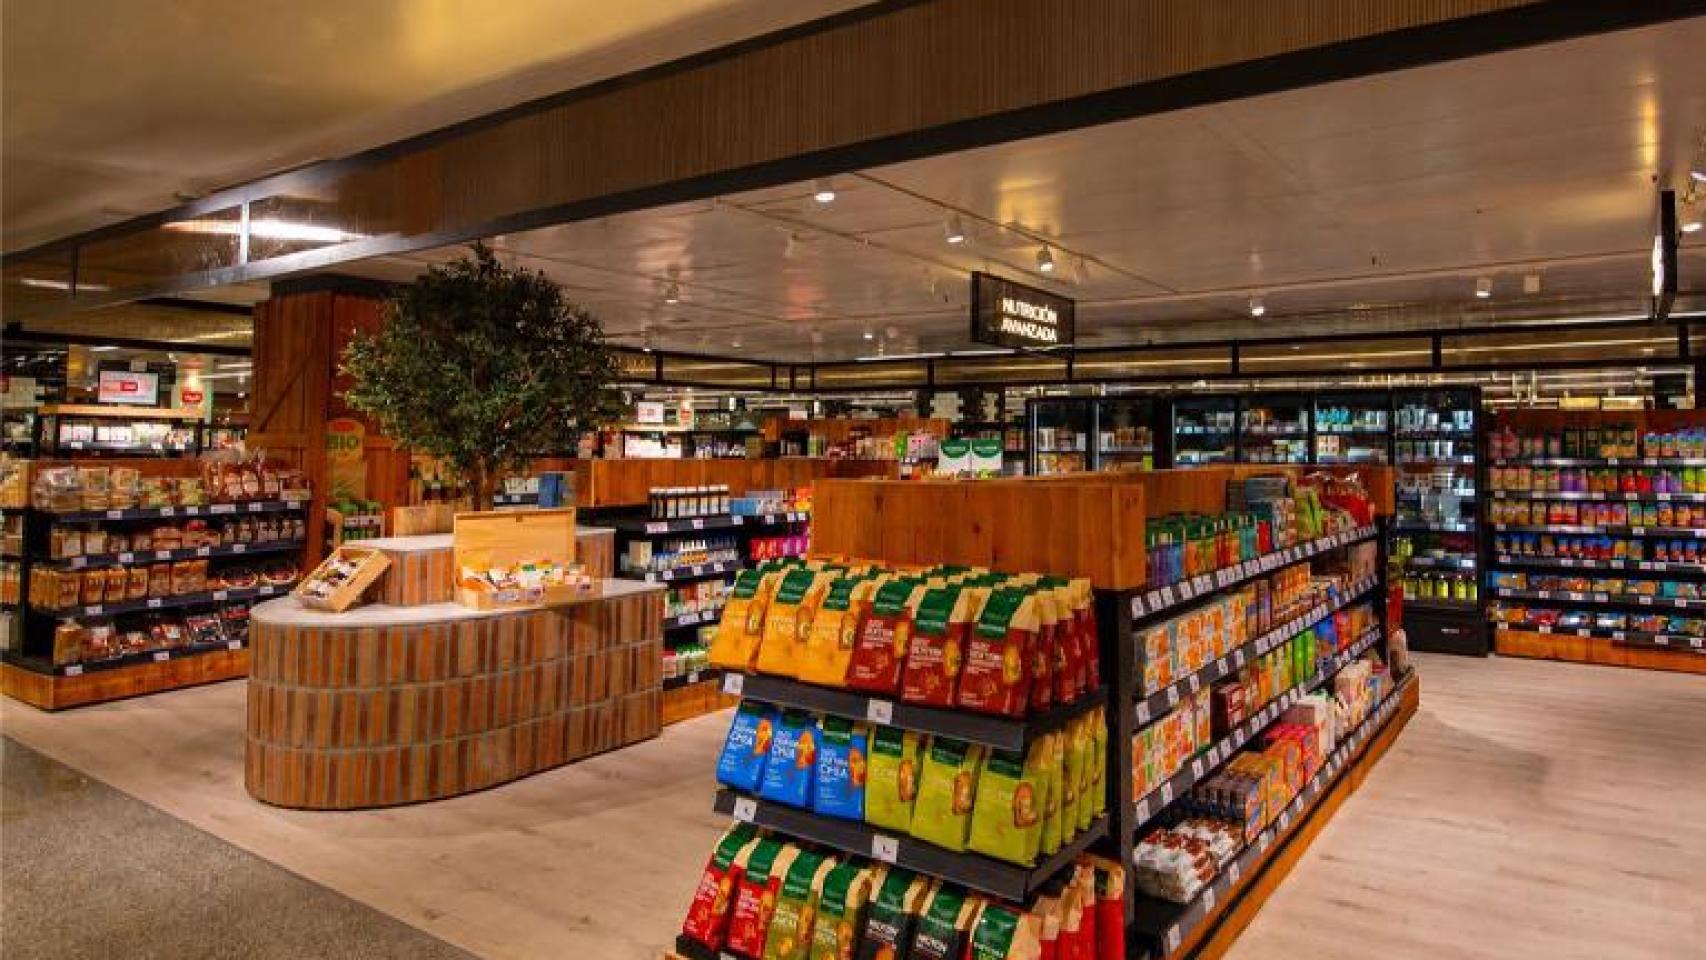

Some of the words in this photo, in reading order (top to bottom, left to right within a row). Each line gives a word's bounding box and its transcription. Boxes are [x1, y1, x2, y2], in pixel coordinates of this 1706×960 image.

[1002, 298, 1057, 324] NUTRICIÓN
[1001, 318, 1057, 342] AVANZADA
[326, 434, 359, 450] BIO
